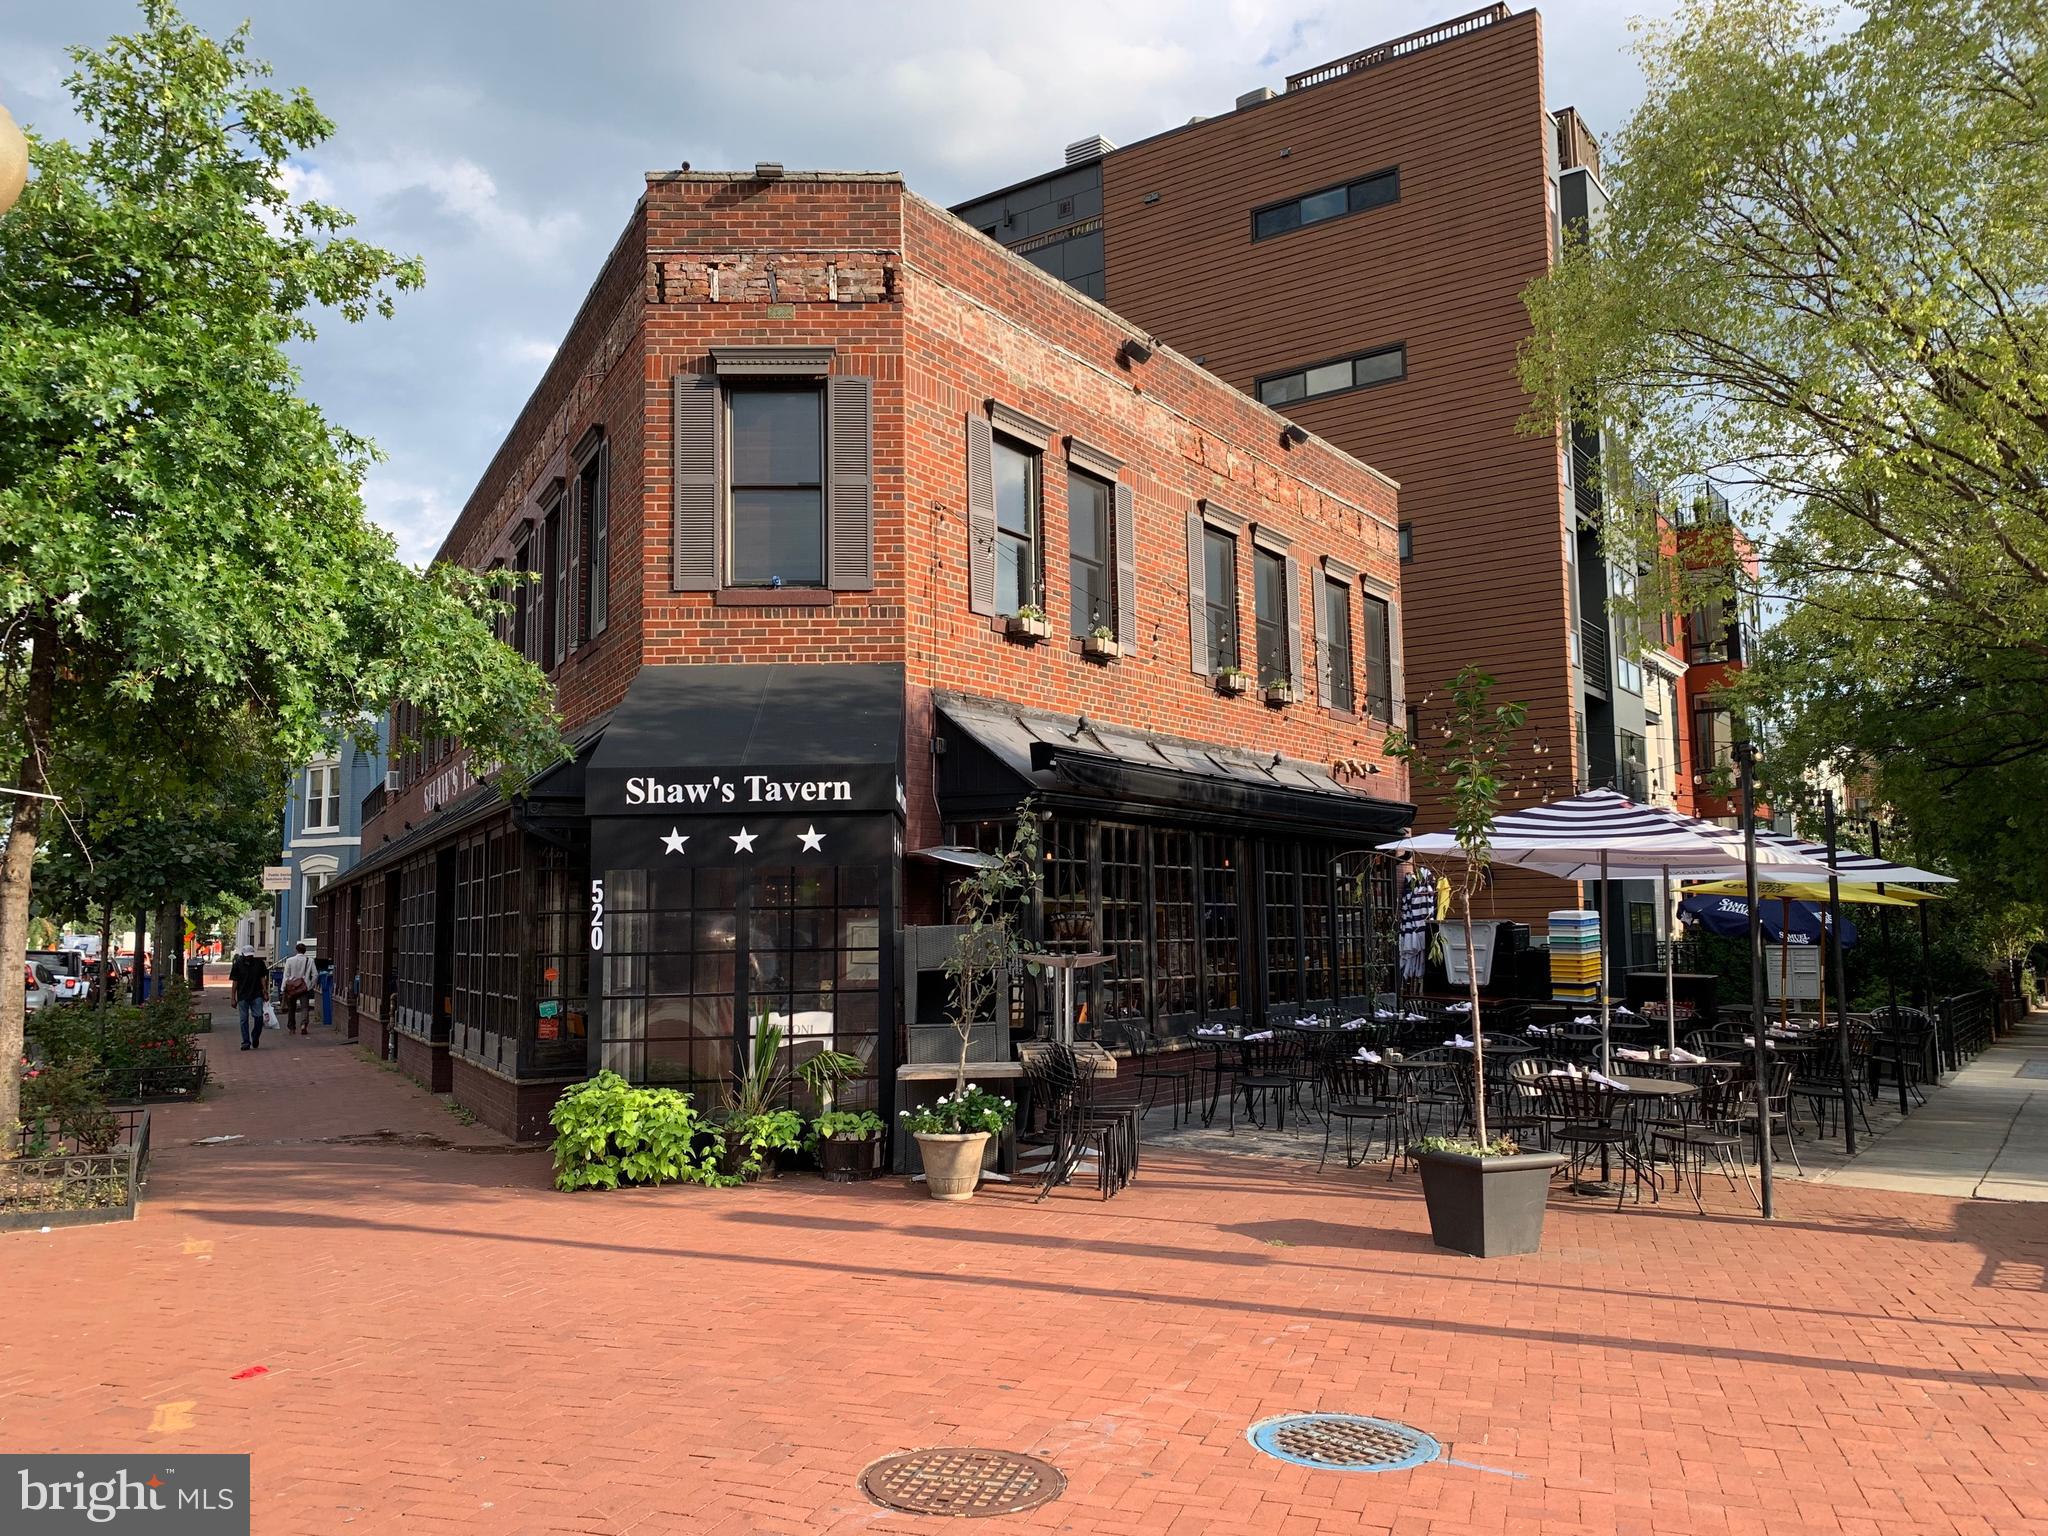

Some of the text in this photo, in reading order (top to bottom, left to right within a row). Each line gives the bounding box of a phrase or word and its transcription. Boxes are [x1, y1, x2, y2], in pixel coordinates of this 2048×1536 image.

[625, 775, 852, 805] Shaw's Tavern
[591, 879, 604, 951] 520
